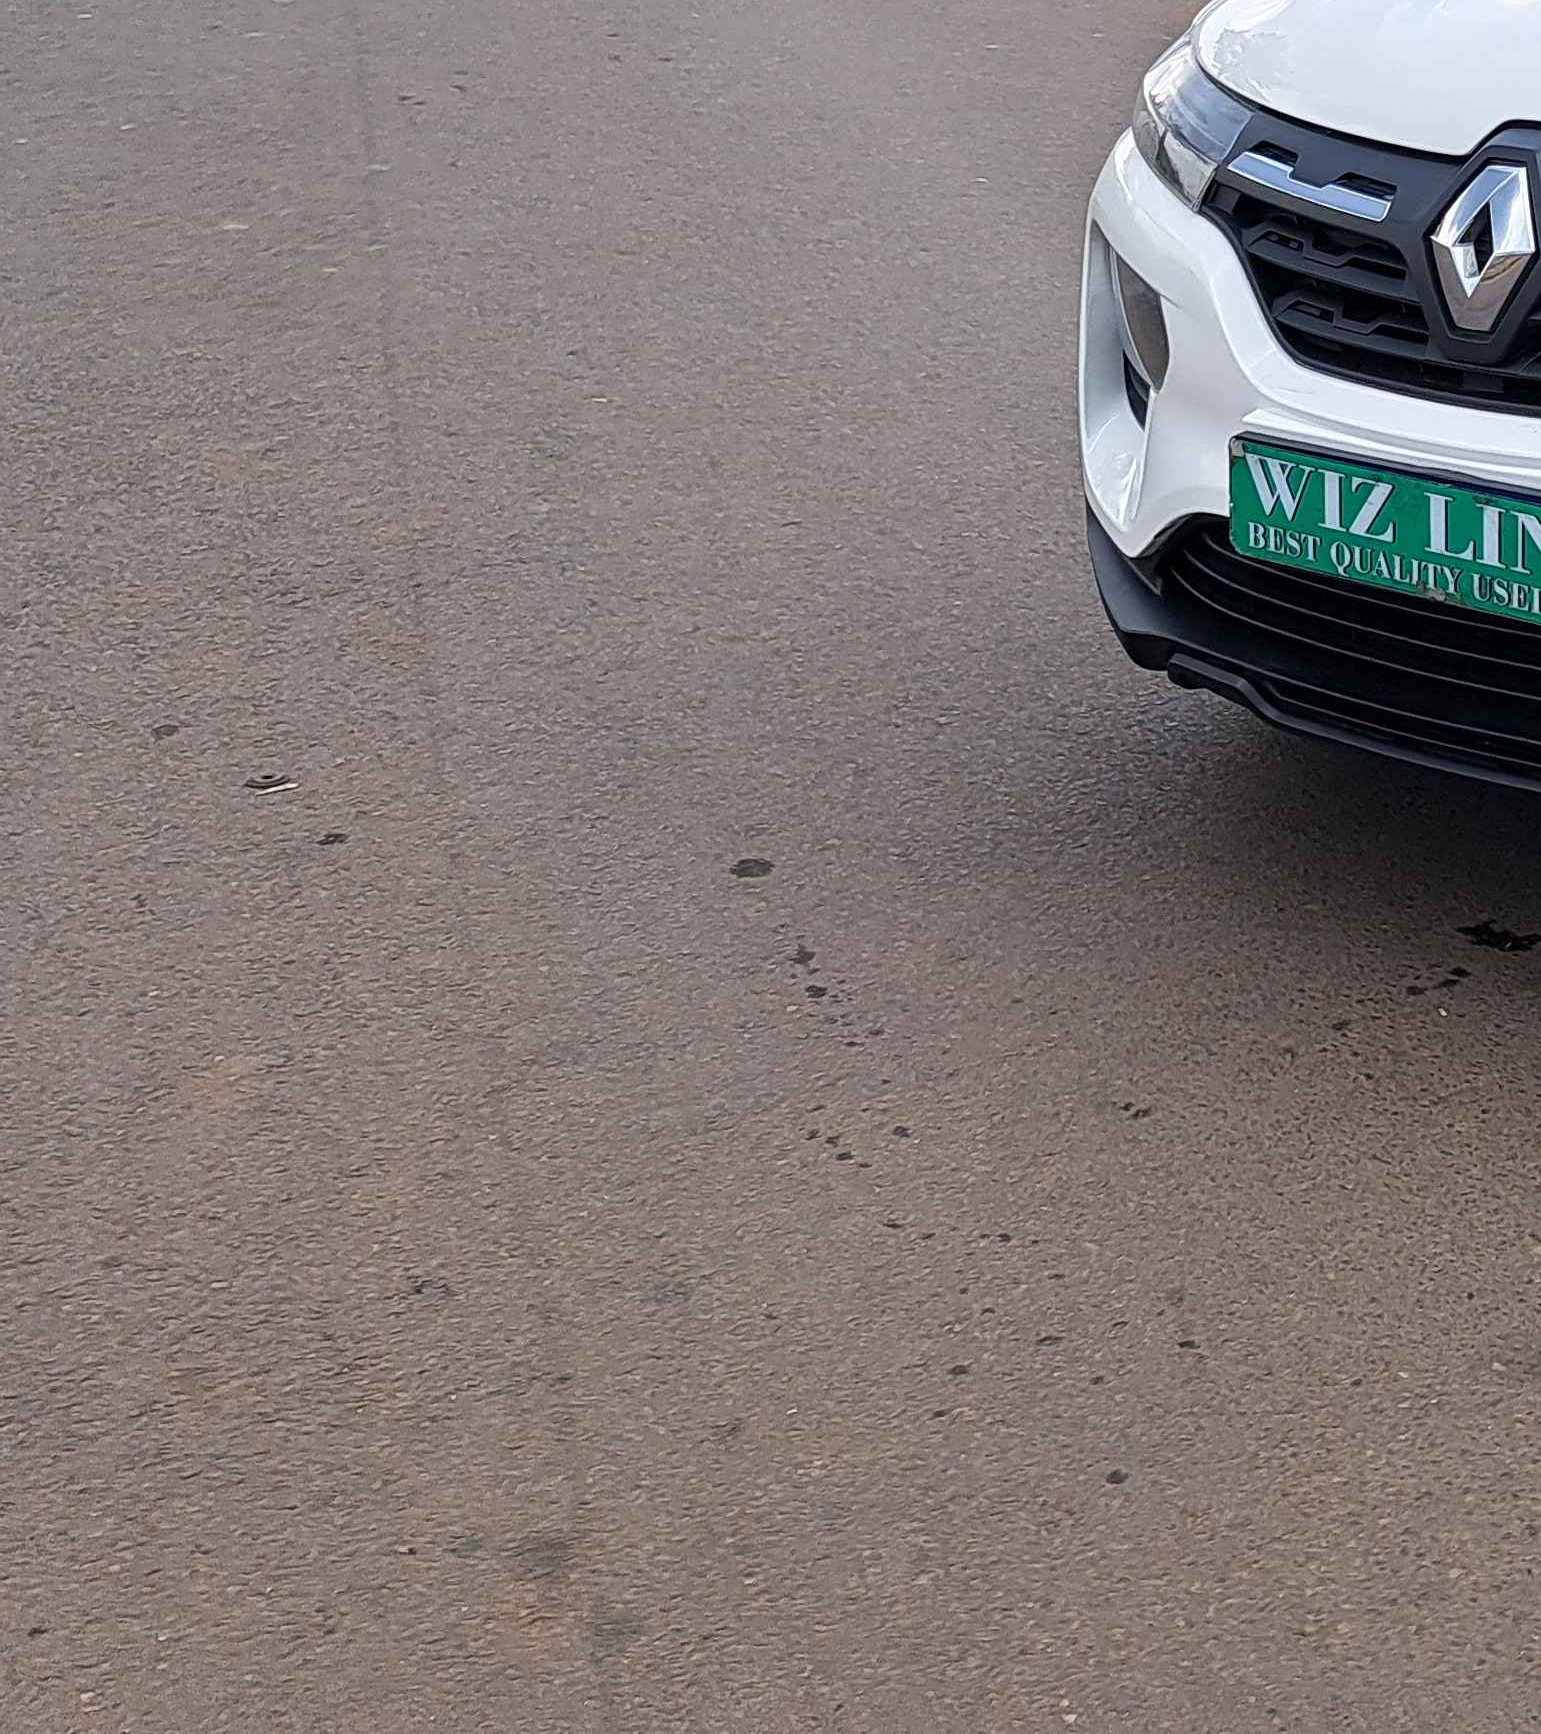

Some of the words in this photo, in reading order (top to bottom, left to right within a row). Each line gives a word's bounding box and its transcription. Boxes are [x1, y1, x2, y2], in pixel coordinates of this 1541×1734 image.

[1246, 452, 1395, 543] WIZ
[1247, 521, 1321, 562] BEST
[1330, 540, 1462, 596] QUALITY
